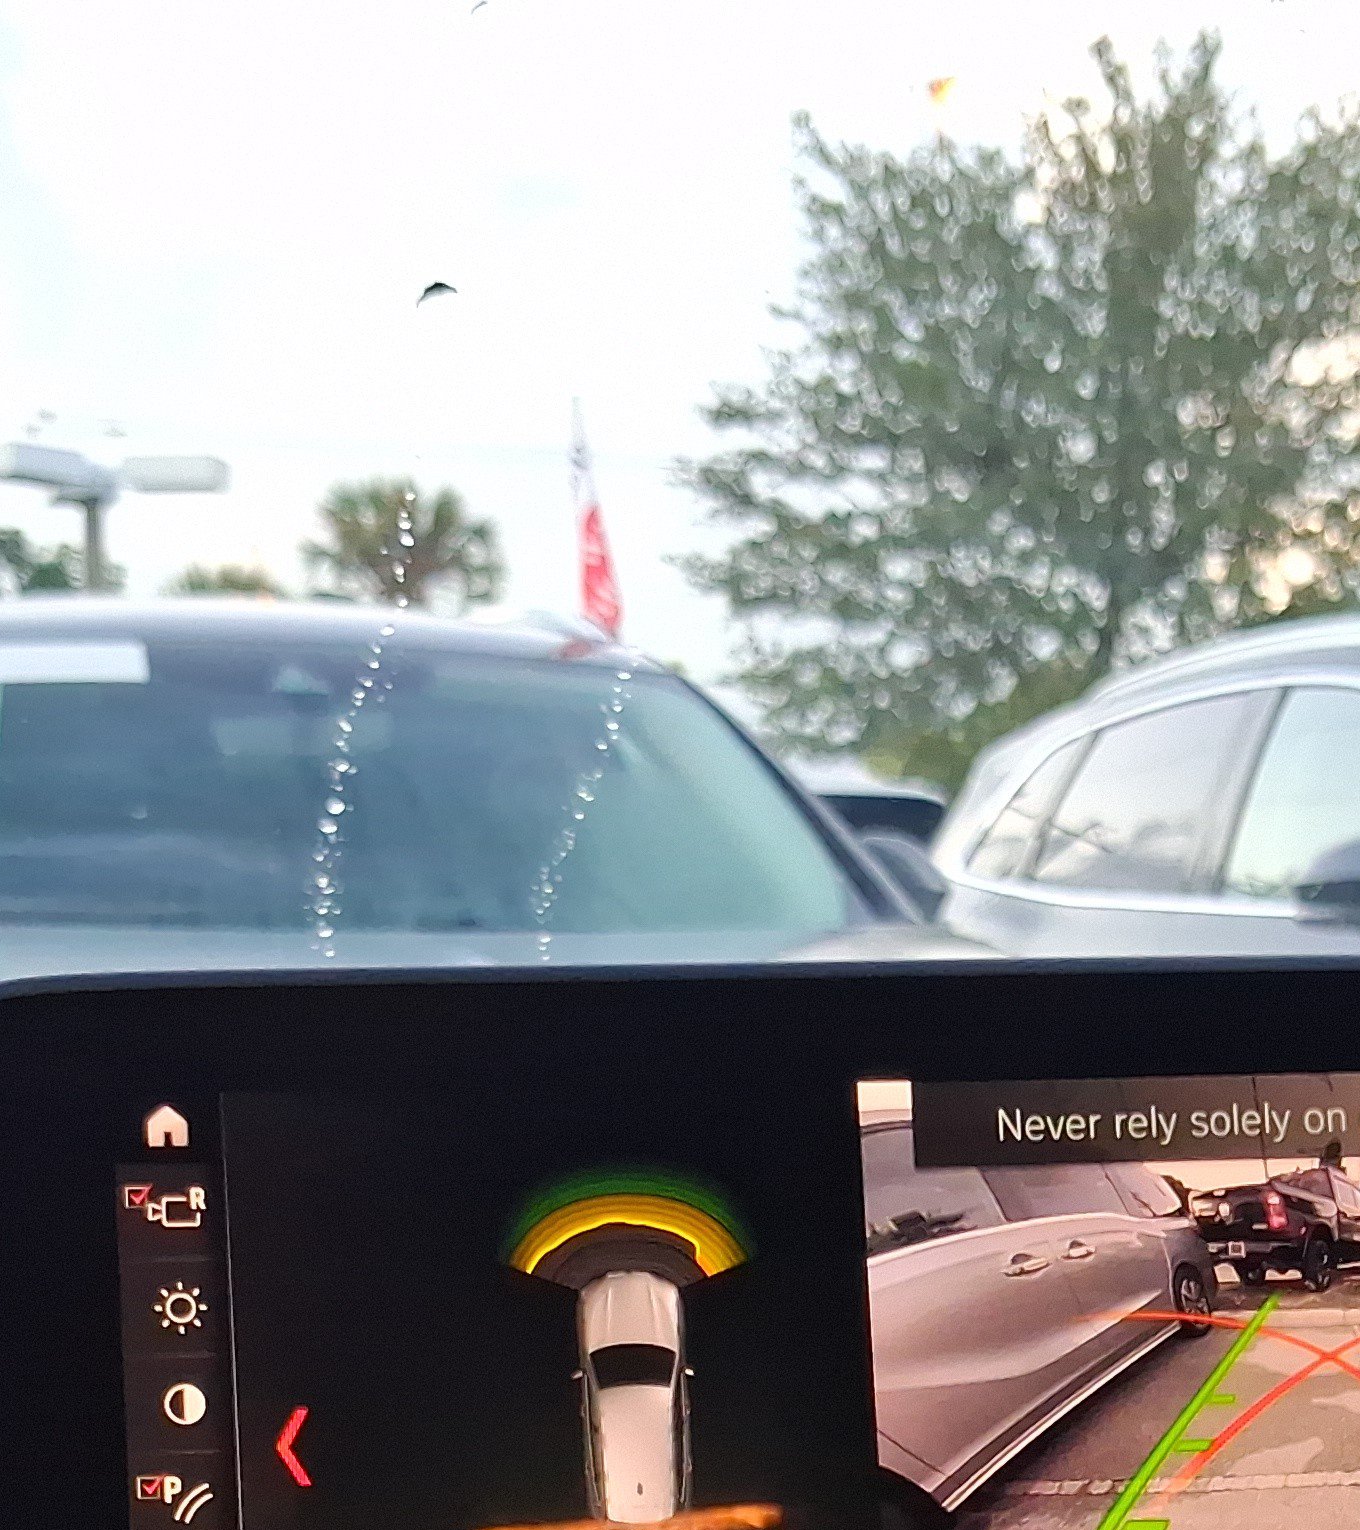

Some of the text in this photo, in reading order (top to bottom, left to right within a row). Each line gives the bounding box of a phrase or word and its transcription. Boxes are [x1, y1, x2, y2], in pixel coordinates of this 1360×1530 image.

[996, 1107, 1102, 1144] Never
[1114, 1103, 1176, 1146] rely
[1190, 1100, 1291, 1144] solely
[1303, 1106, 1347, 1134] on
[189, 1187, 207, 1210] R
[164, 1475, 182, 1504] P
